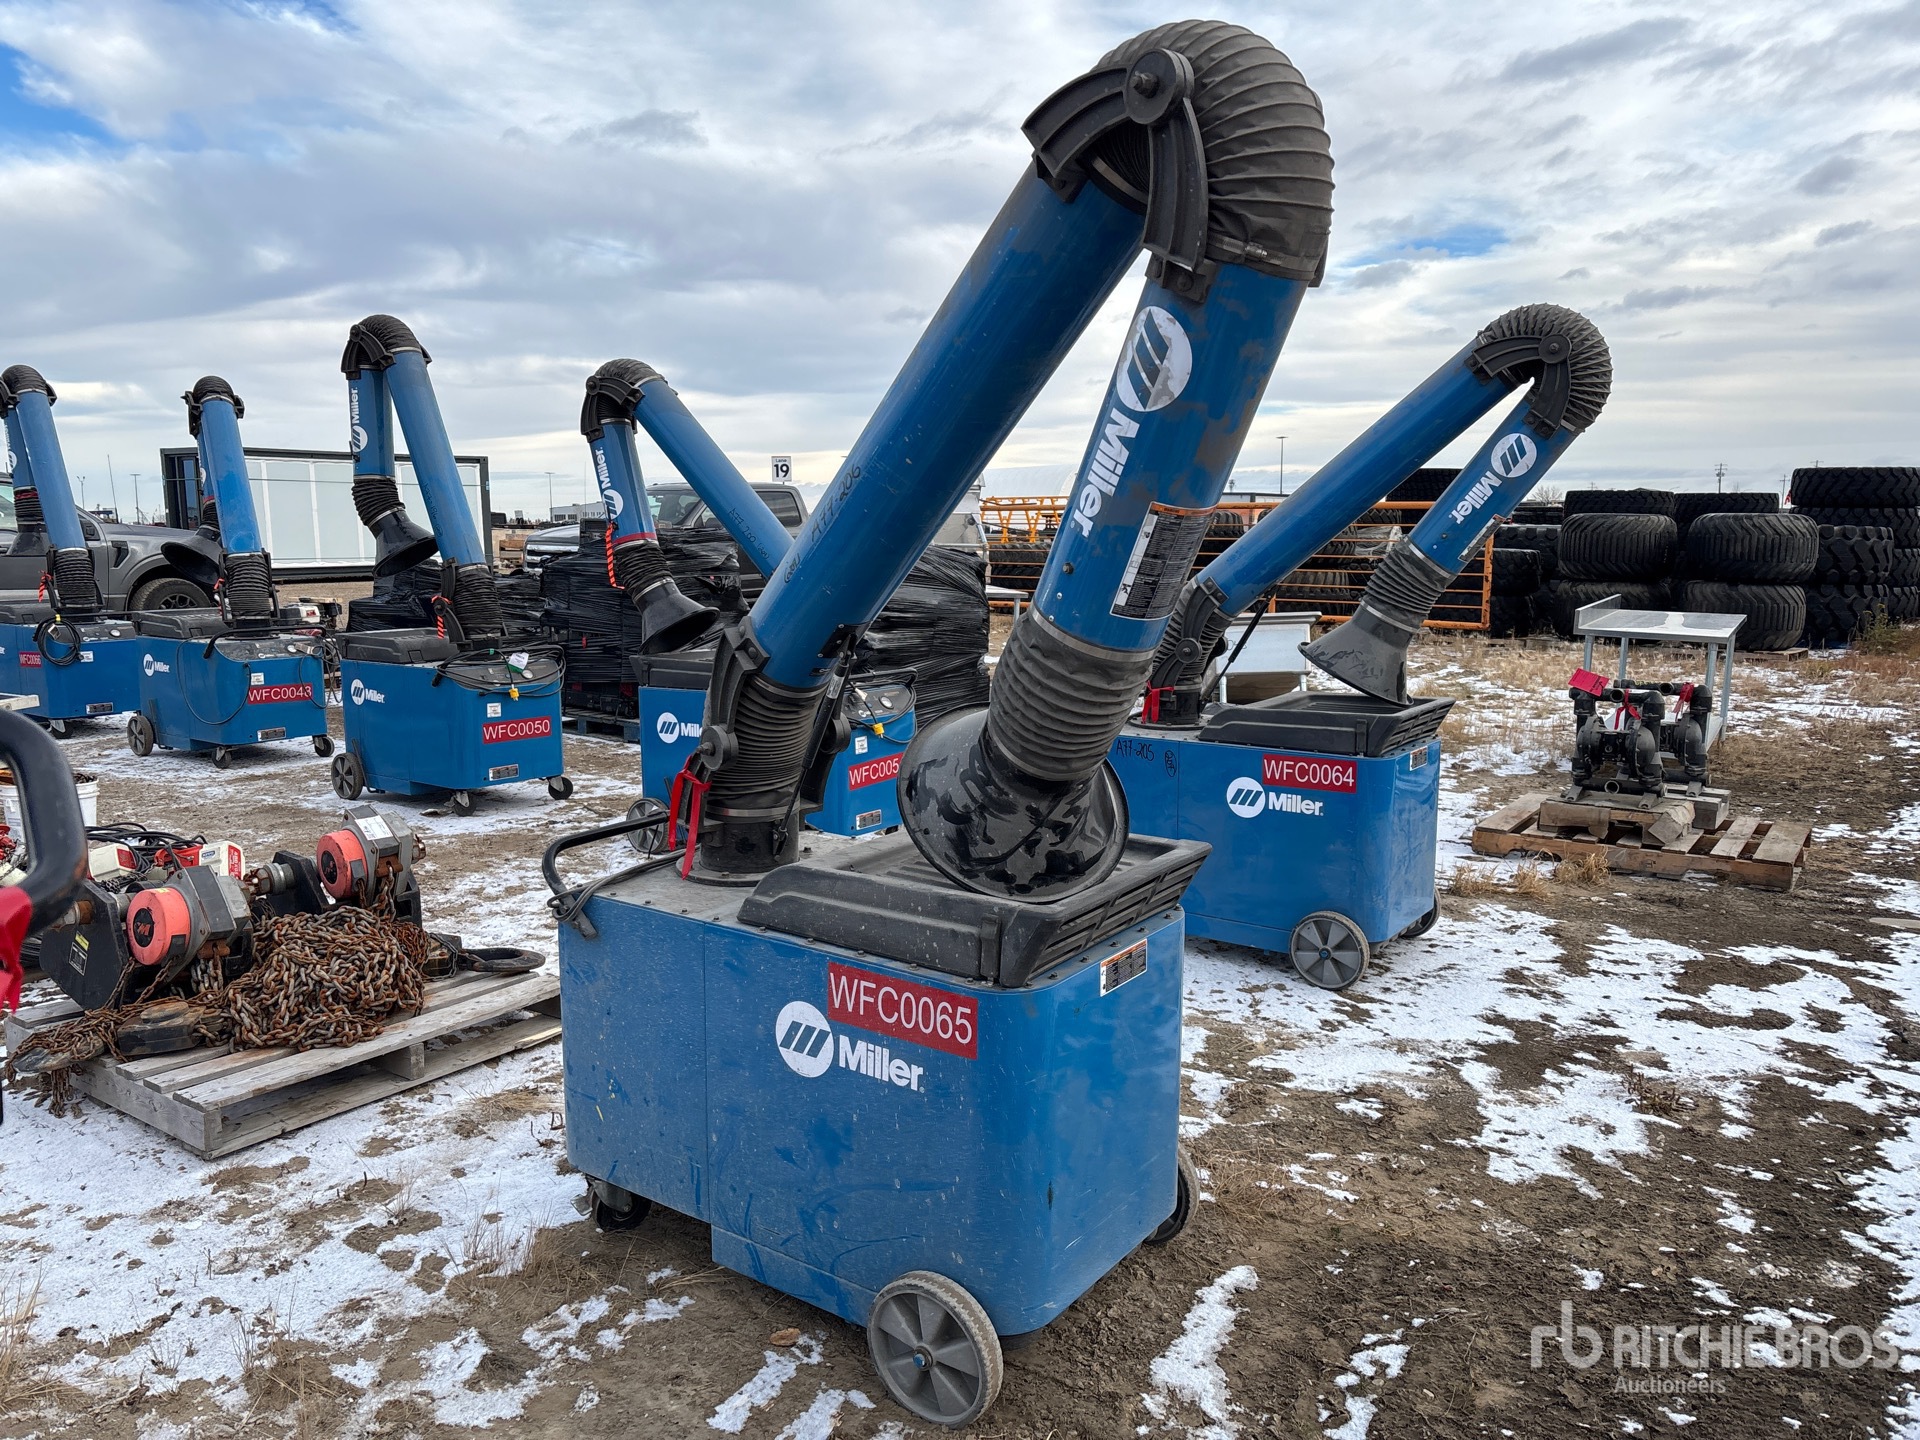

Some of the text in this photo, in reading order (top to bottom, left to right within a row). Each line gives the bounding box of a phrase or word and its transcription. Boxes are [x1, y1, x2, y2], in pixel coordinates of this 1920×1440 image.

[351, 387, 360, 424] Miller
[595, 449, 612, 488] Miller
[774, 464, 790, 478] 19
[1072, 407, 1141, 539] Miller
[1451, 470, 1503, 525] Miller
[154, 661, 171, 674] Miller
[365, 688, 385, 703] Miller
[483, 719, 551, 741] WFC0050
[849, 757, 899, 786] WFC005
[1263, 758, 1355, 787] WFC0064
[1268, 791, 1324, 816] Miller
[829, 972, 973, 1045] WFC0065
[838, 1034, 925, 1092] Miller
